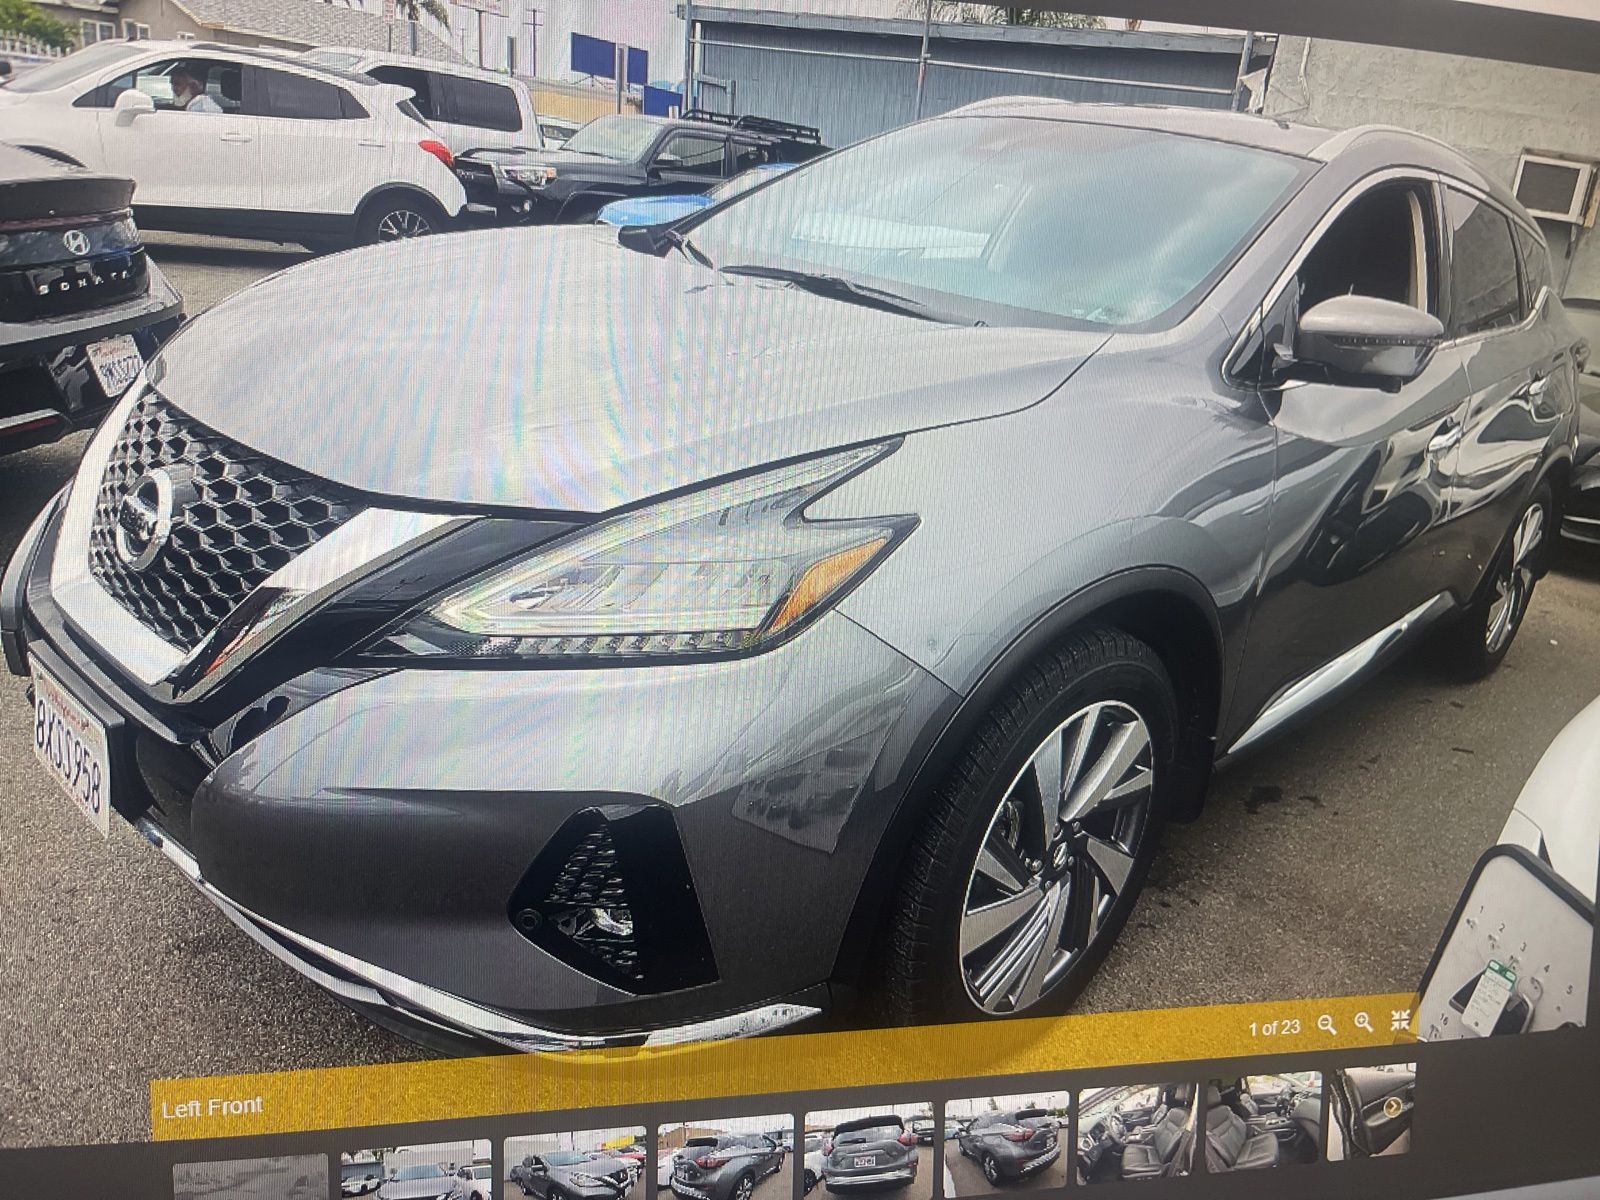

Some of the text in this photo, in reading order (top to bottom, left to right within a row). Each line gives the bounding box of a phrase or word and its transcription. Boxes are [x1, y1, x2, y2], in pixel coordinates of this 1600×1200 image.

[38, 269, 130, 295] SONATA
[1499, 923, 1506, 932] 2
[1520, 942, 1527, 952] 3
[1543, 964, 1550, 973] 4
[1566, 985, 1574, 995] 5
[1249, 1019, 1301, 1037] 1 of 23
[162, 1095, 264, 1119] Left Front
